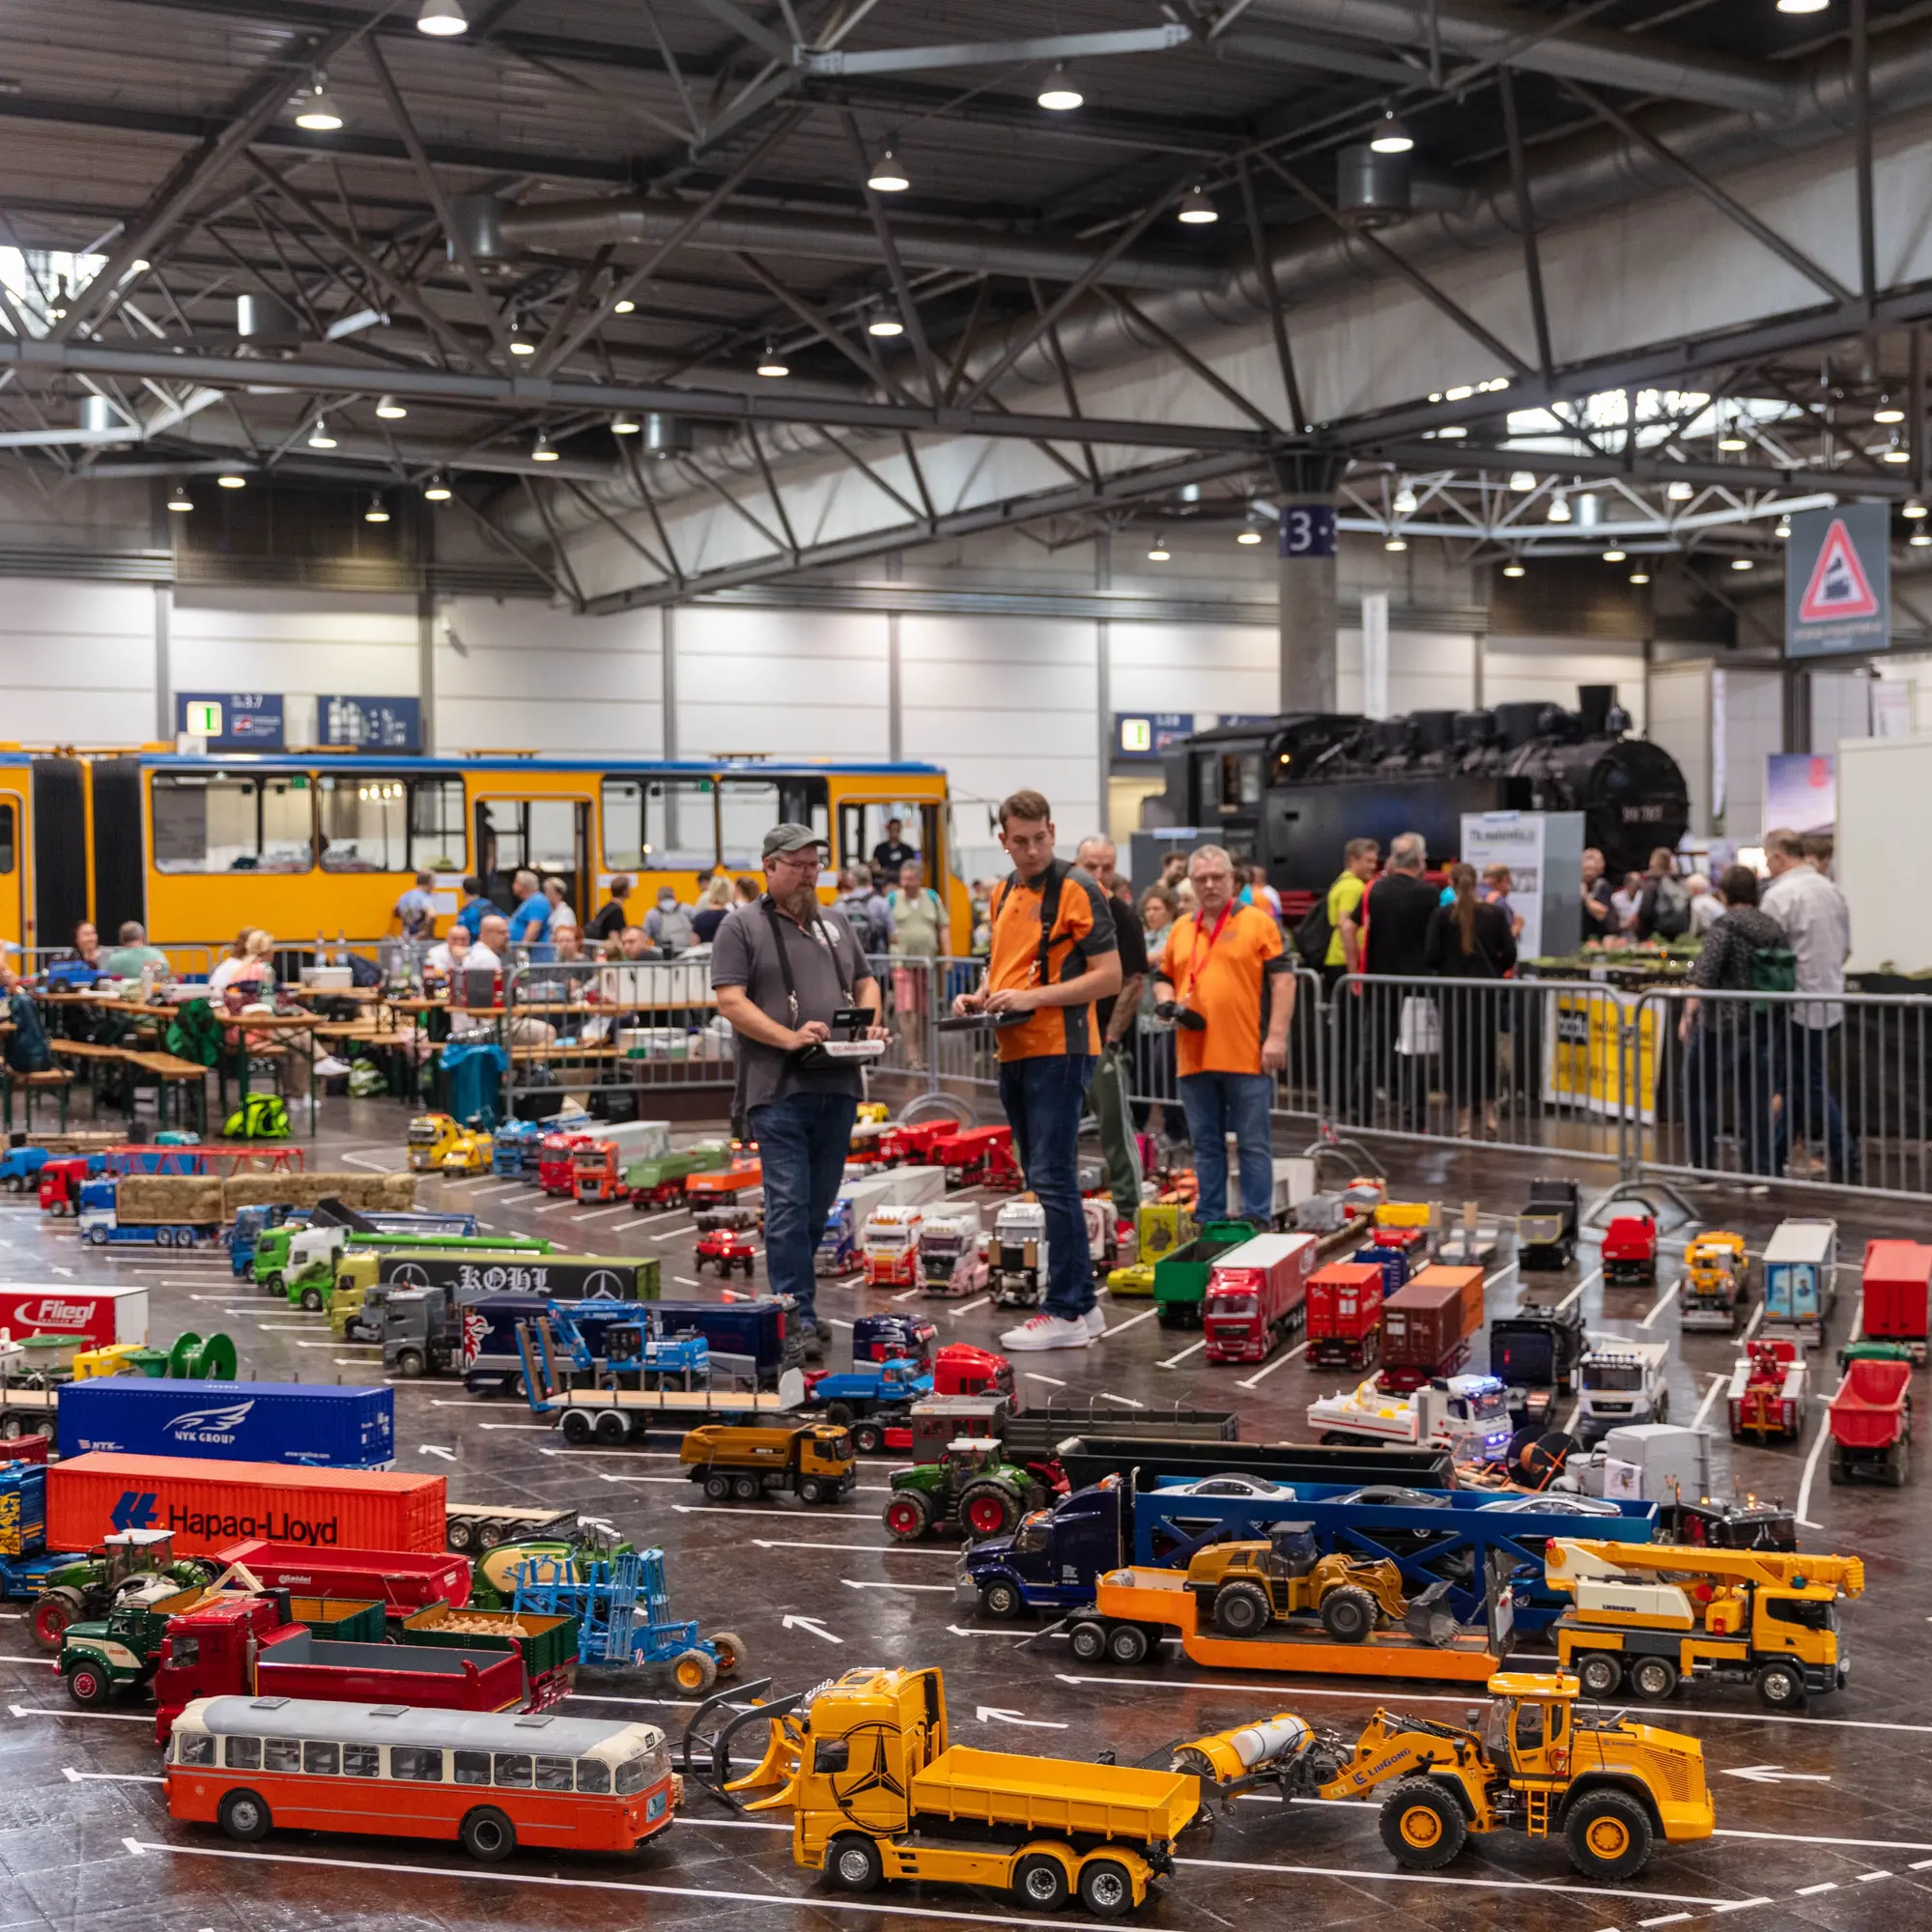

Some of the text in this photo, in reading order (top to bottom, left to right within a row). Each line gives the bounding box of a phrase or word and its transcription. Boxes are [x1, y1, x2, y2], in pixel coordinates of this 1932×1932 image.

[1290, 510, 1313, 552] 3
[39, 1299, 97, 1324] Fliegl
[175, 1431, 236, 1444] NYK GROUP
[169, 1504, 337, 1546] Hapag-Lloyd
